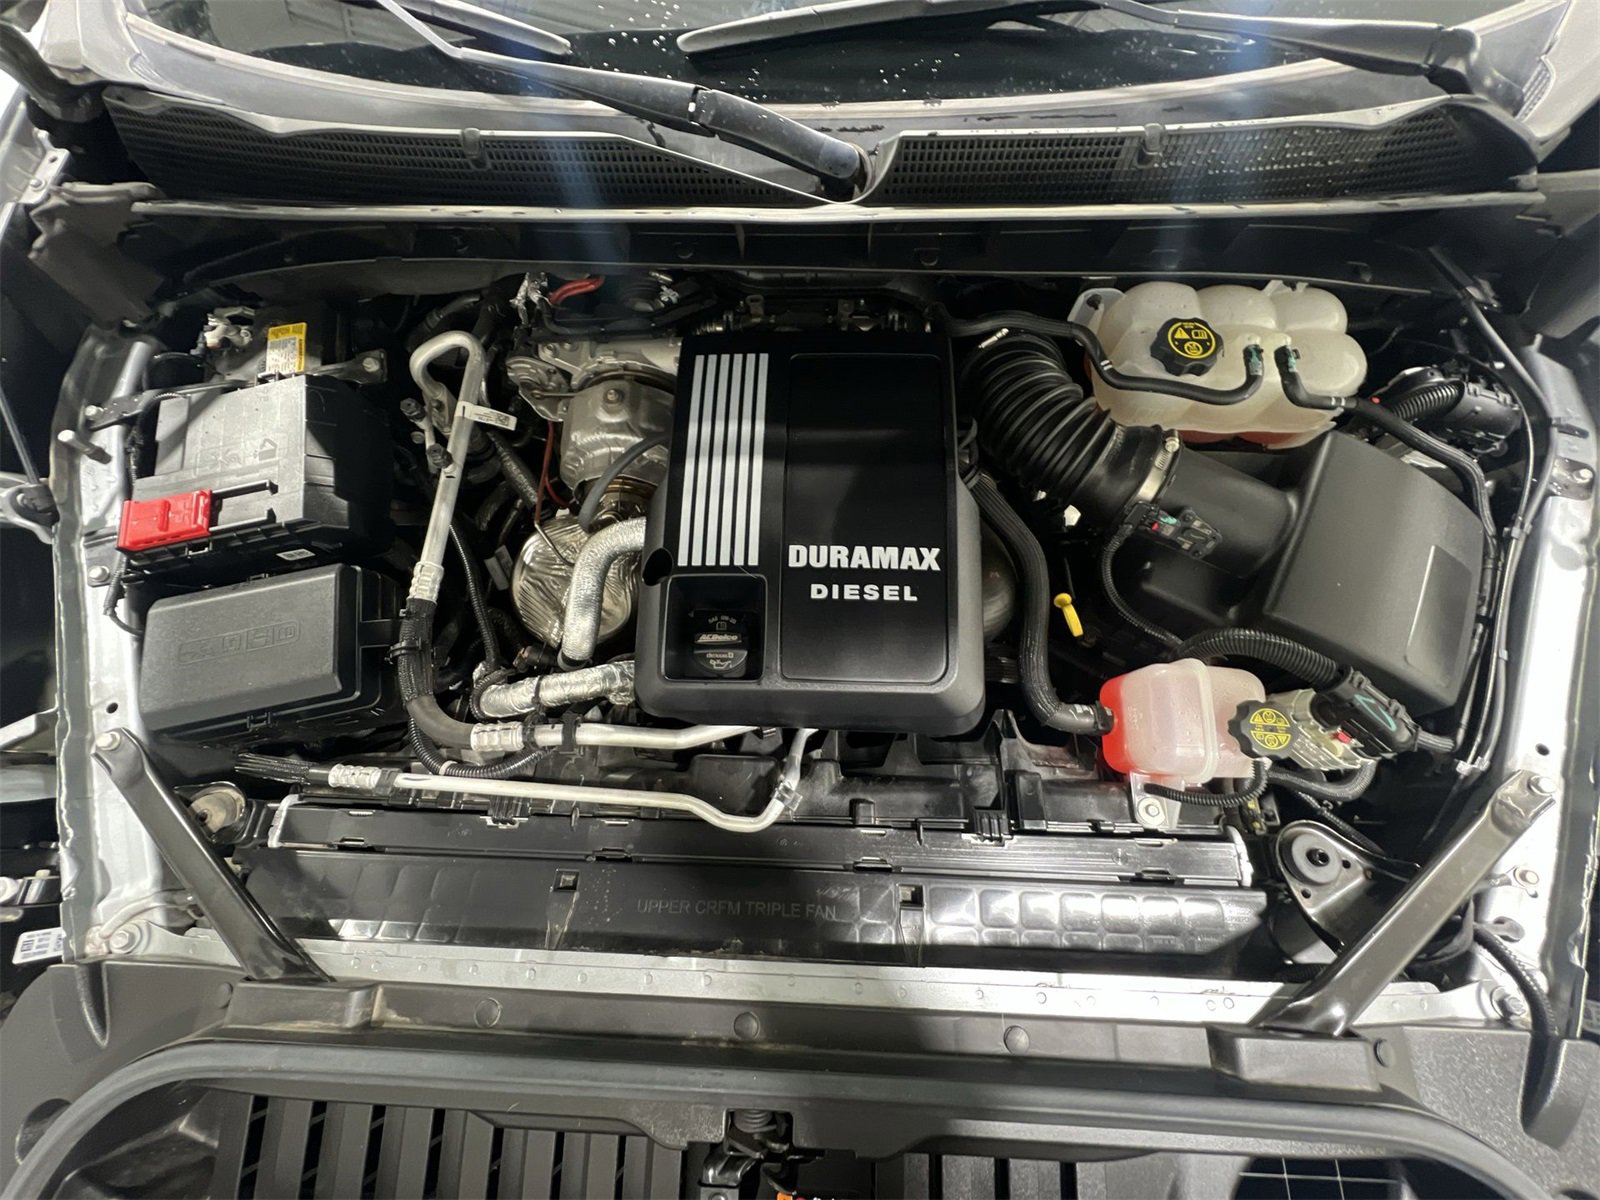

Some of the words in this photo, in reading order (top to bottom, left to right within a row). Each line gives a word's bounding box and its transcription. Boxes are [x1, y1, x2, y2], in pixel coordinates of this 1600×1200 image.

[788, 545, 941, 571] DURAMAX
[810, 583, 918, 601] DIESEL
[637, 898, 690, 914] UPPER
[746, 901, 801, 918] TRIPLE
[805, 903, 837, 920] FAN
